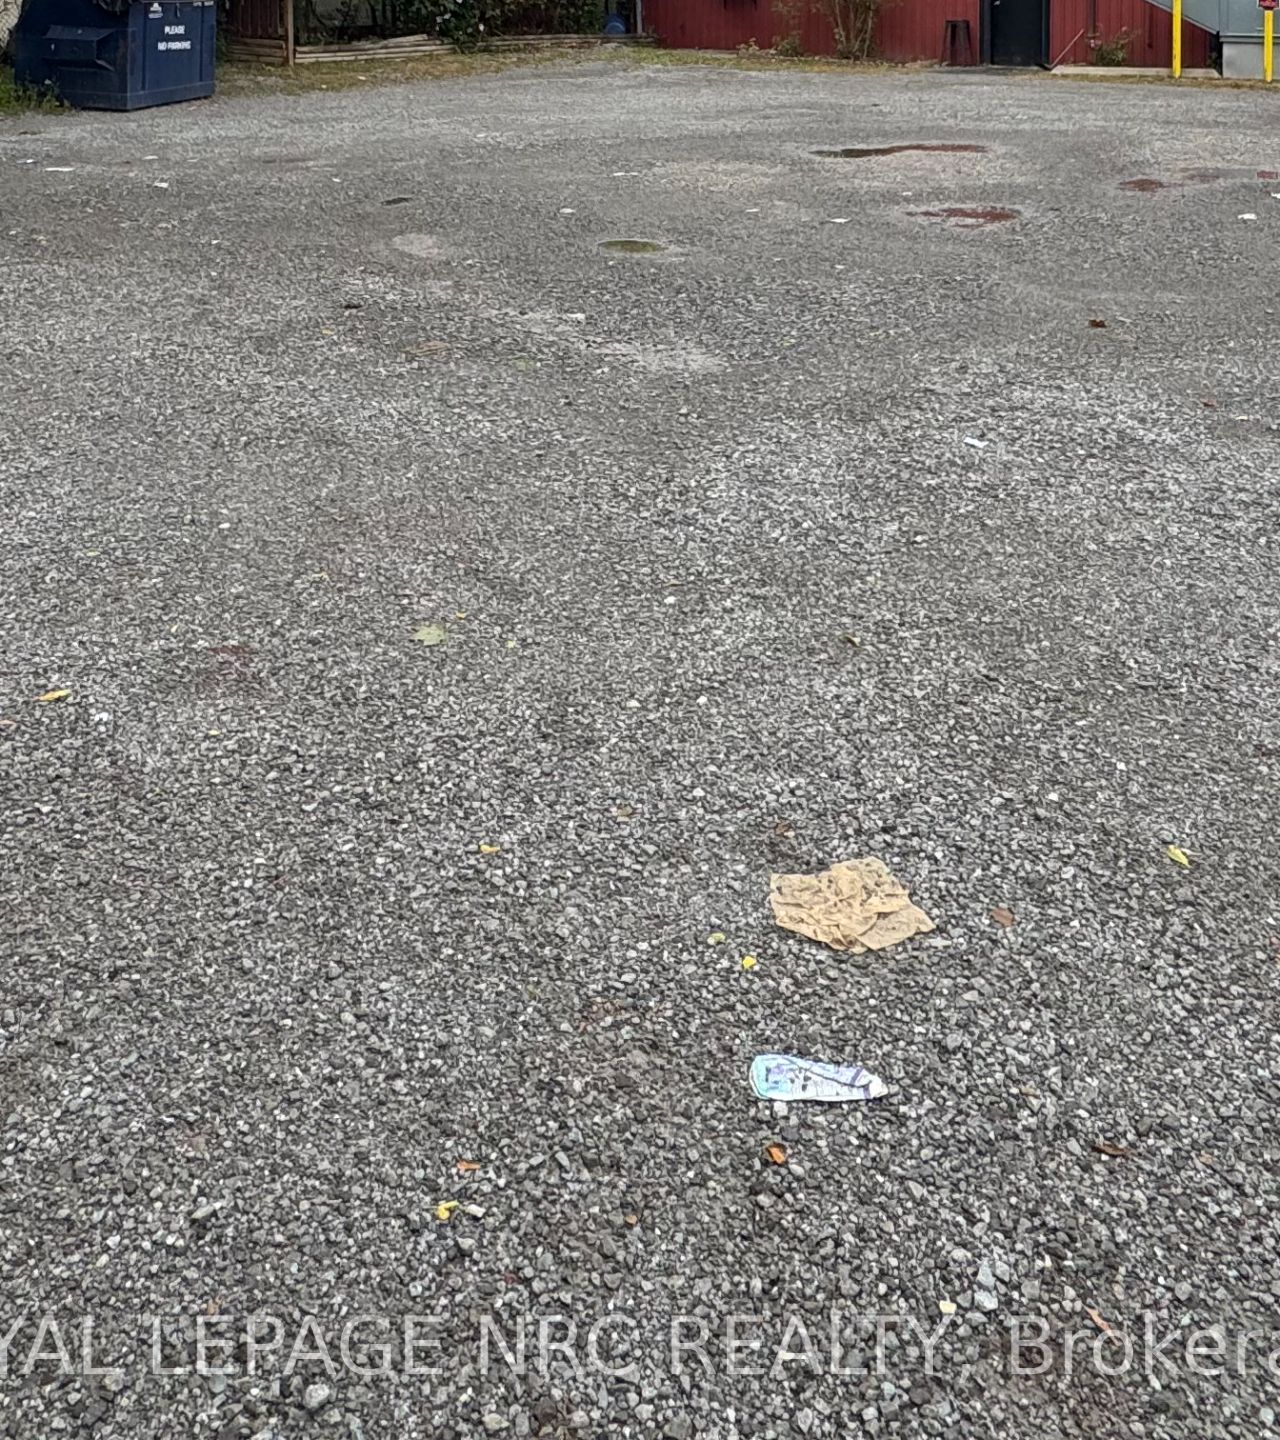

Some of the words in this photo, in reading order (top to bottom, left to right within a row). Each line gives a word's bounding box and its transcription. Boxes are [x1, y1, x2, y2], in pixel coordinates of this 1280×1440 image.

[164, 25, 185, 34] PLEASE
[157, 41, 167, 51] NO
[168, 41, 191, 50] PARKING
